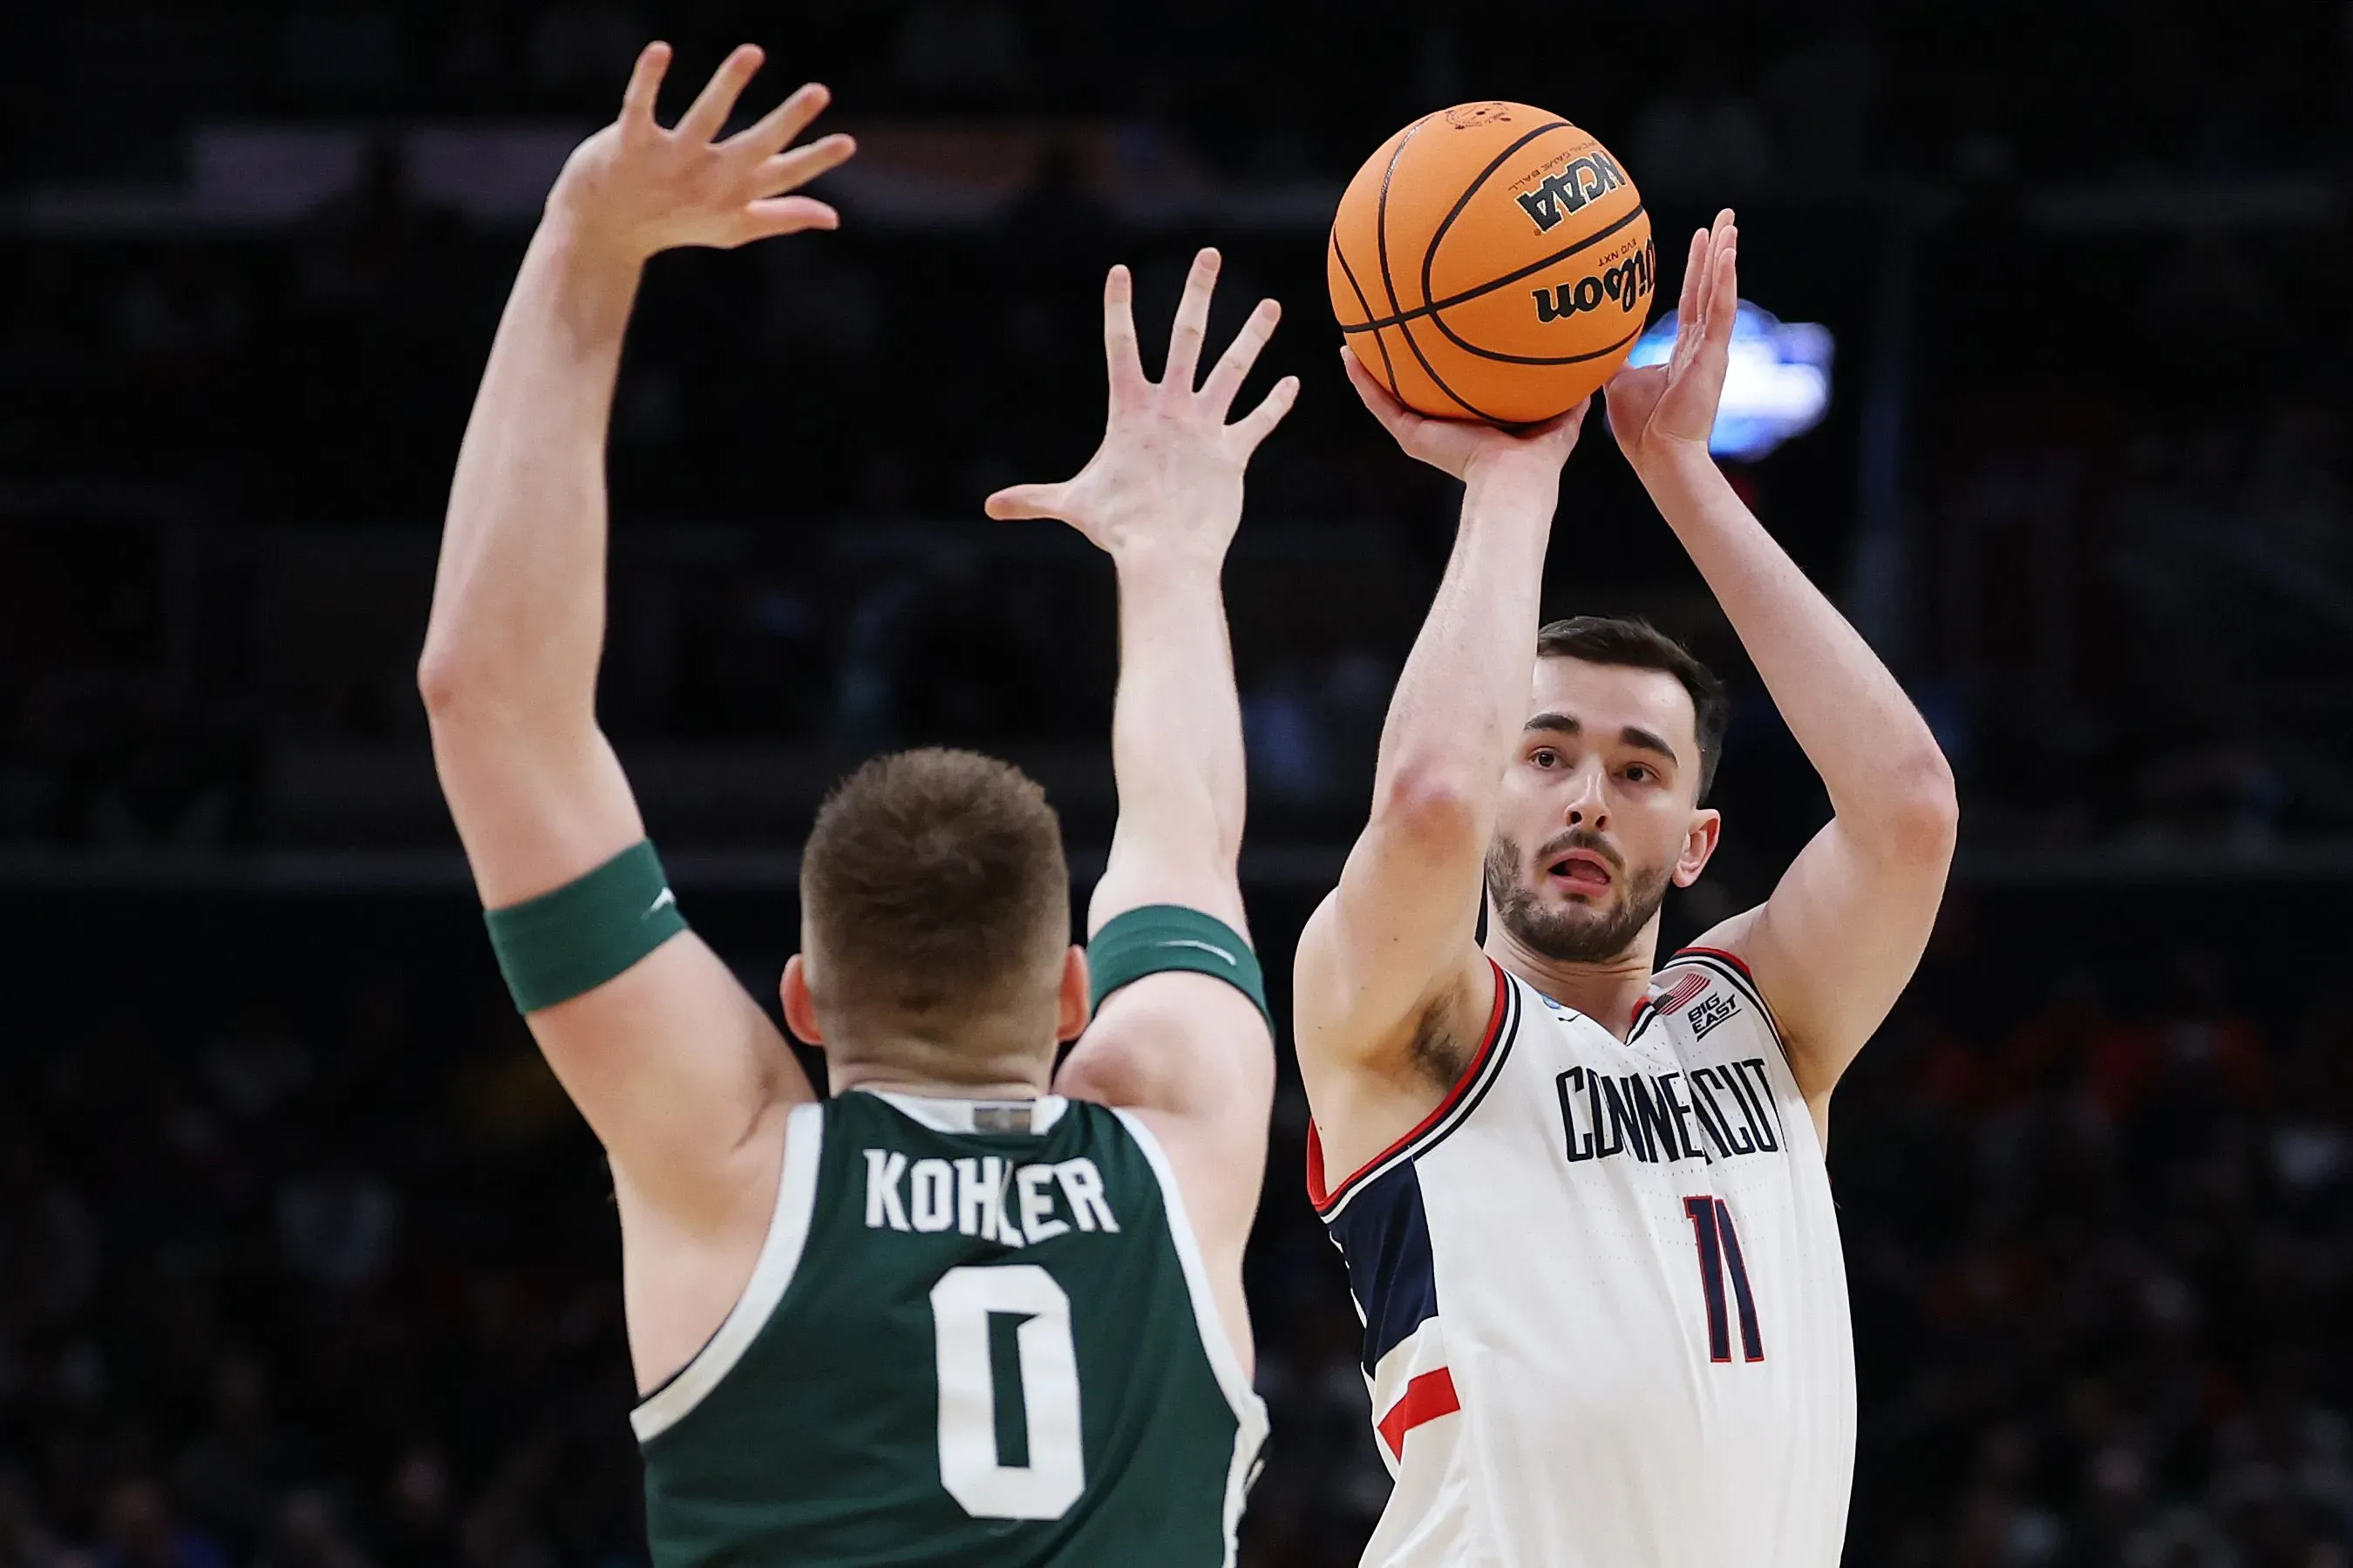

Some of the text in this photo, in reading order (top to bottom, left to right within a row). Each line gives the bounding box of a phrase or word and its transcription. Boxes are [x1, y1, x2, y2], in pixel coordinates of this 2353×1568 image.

[1508, 169, 1540, 192] BALL
[1513, 150, 1627, 234] NCAA
[1598, 249, 1620, 268] NXT
[1687, 990, 1721, 1023] BIG
[1691, 994, 1737, 1035] EAST
[1683, 1195, 1765, 1364] 11
[929, 1264, 1086, 1521] 0
